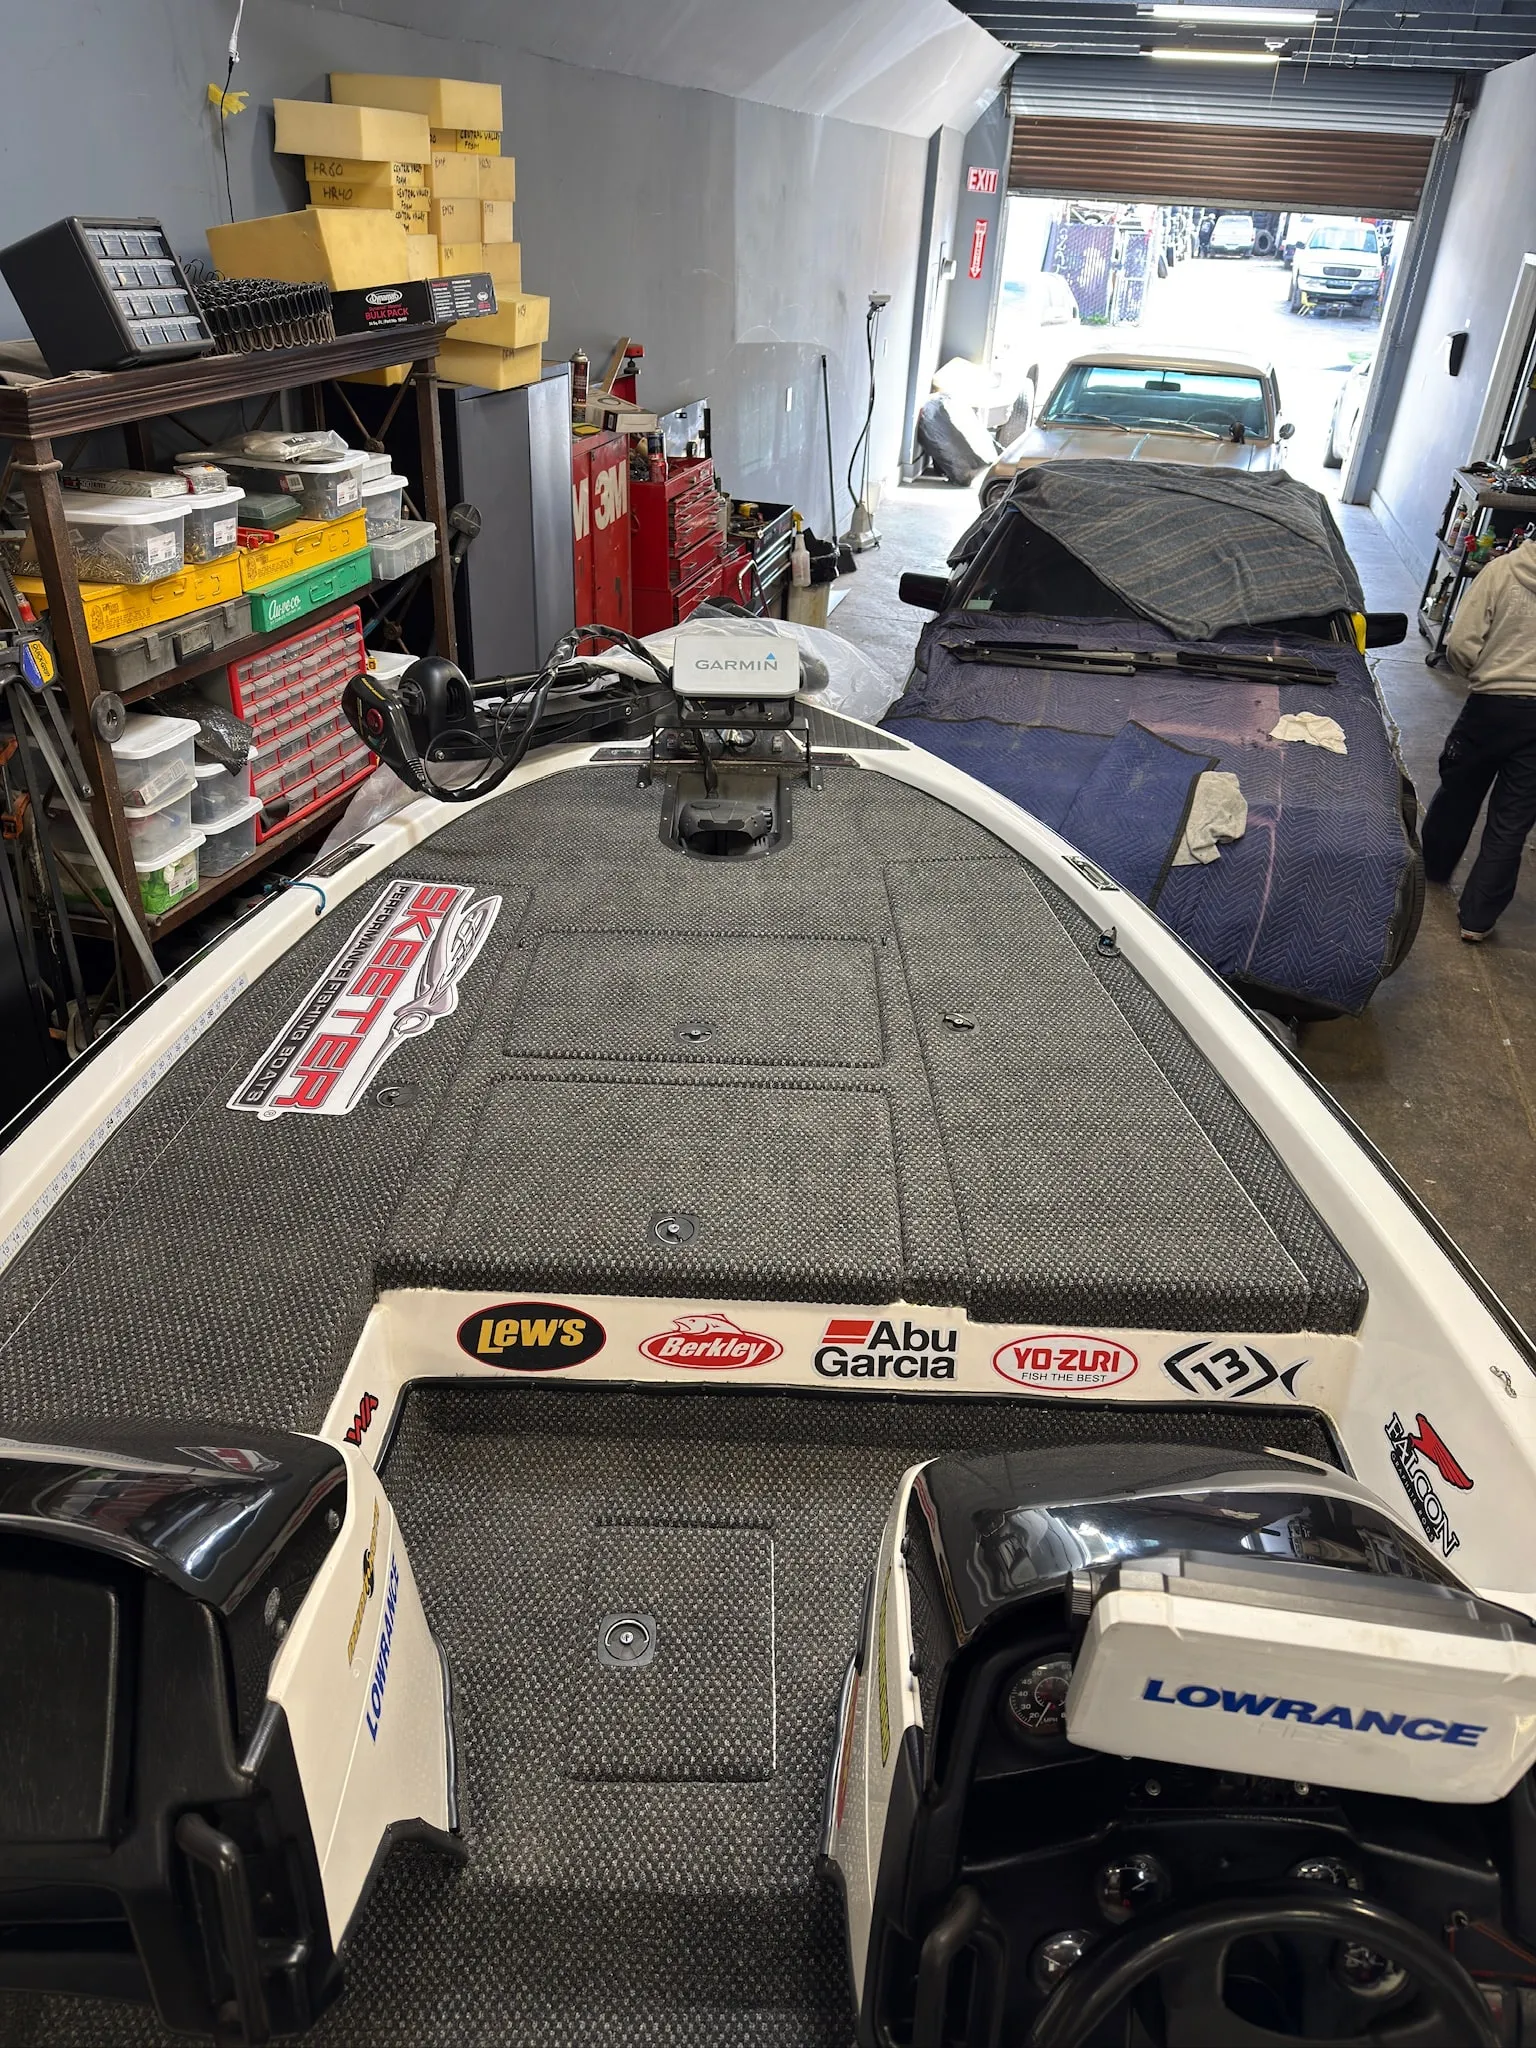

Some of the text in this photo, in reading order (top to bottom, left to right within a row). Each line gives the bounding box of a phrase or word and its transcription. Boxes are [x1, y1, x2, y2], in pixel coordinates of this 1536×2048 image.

[968, 168, 997, 193] EXIT
[365, 311, 387, 321] BULK
[387, 307, 409, 318] PACK
[594, 459, 628, 531] 3M
[695, 659, 778, 671] GARMIN
[248, 885, 409, 1101] PERFORMANCE FISHING BOATS
[270, 886, 460, 1109] SKEETER
[658, 1335, 767, 1366] Berkley
[867, 1320, 958, 1352] Abu
[813, 1345, 956, 1379] Garcia
[1013, 1347, 1120, 1373] YO-ZURI
[1190, 1347, 1250, 1391] 13
[1021, 1372, 1107, 1383] FISH THE BEST
[1385, 1412, 1460, 1557] FALCON
[366, 1552, 400, 1743] LOWRANCE
[1142, 1677, 1488, 1748] LOWRANCE
